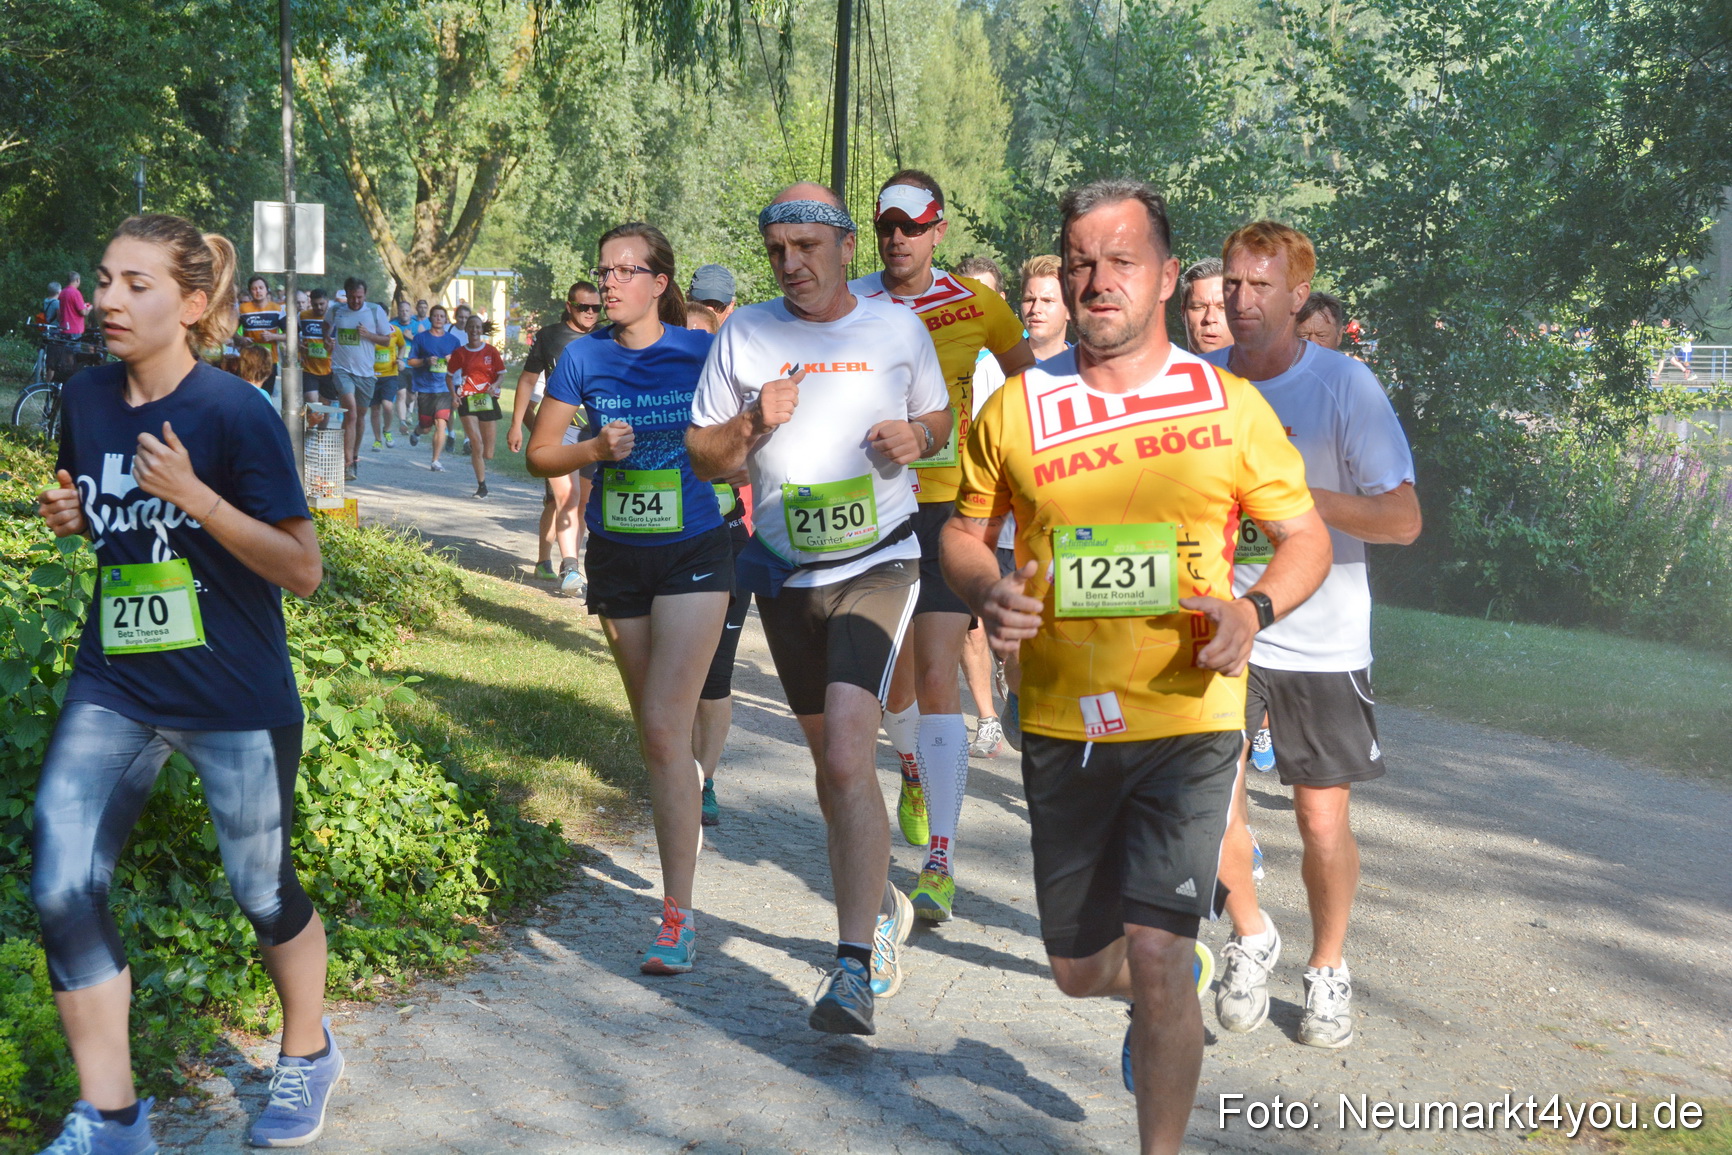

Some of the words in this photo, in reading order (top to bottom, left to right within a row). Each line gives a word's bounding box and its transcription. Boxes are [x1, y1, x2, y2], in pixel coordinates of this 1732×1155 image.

[925, 304, 984, 332] BÖGL
[804, 361, 874, 374] KLEBL
[595, 394, 632, 409] Freie
[1033, 443, 1124, 487] MAX
[1134, 424, 1233, 459] BÖGL
[617, 492, 663, 516] 754
[628, 515, 644, 523] Guro
[794, 502, 865, 533] 2150
[806, 535, 844, 547] Günter
[1069, 556, 1156, 590] 1231
[1085, 591, 1109, 600] Benz
[1111, 590, 1145, 599] Ronald
[113, 595, 169, 629] 270
[118, 630, 134, 639] Betz
[136, 628, 170, 637] Theresa
